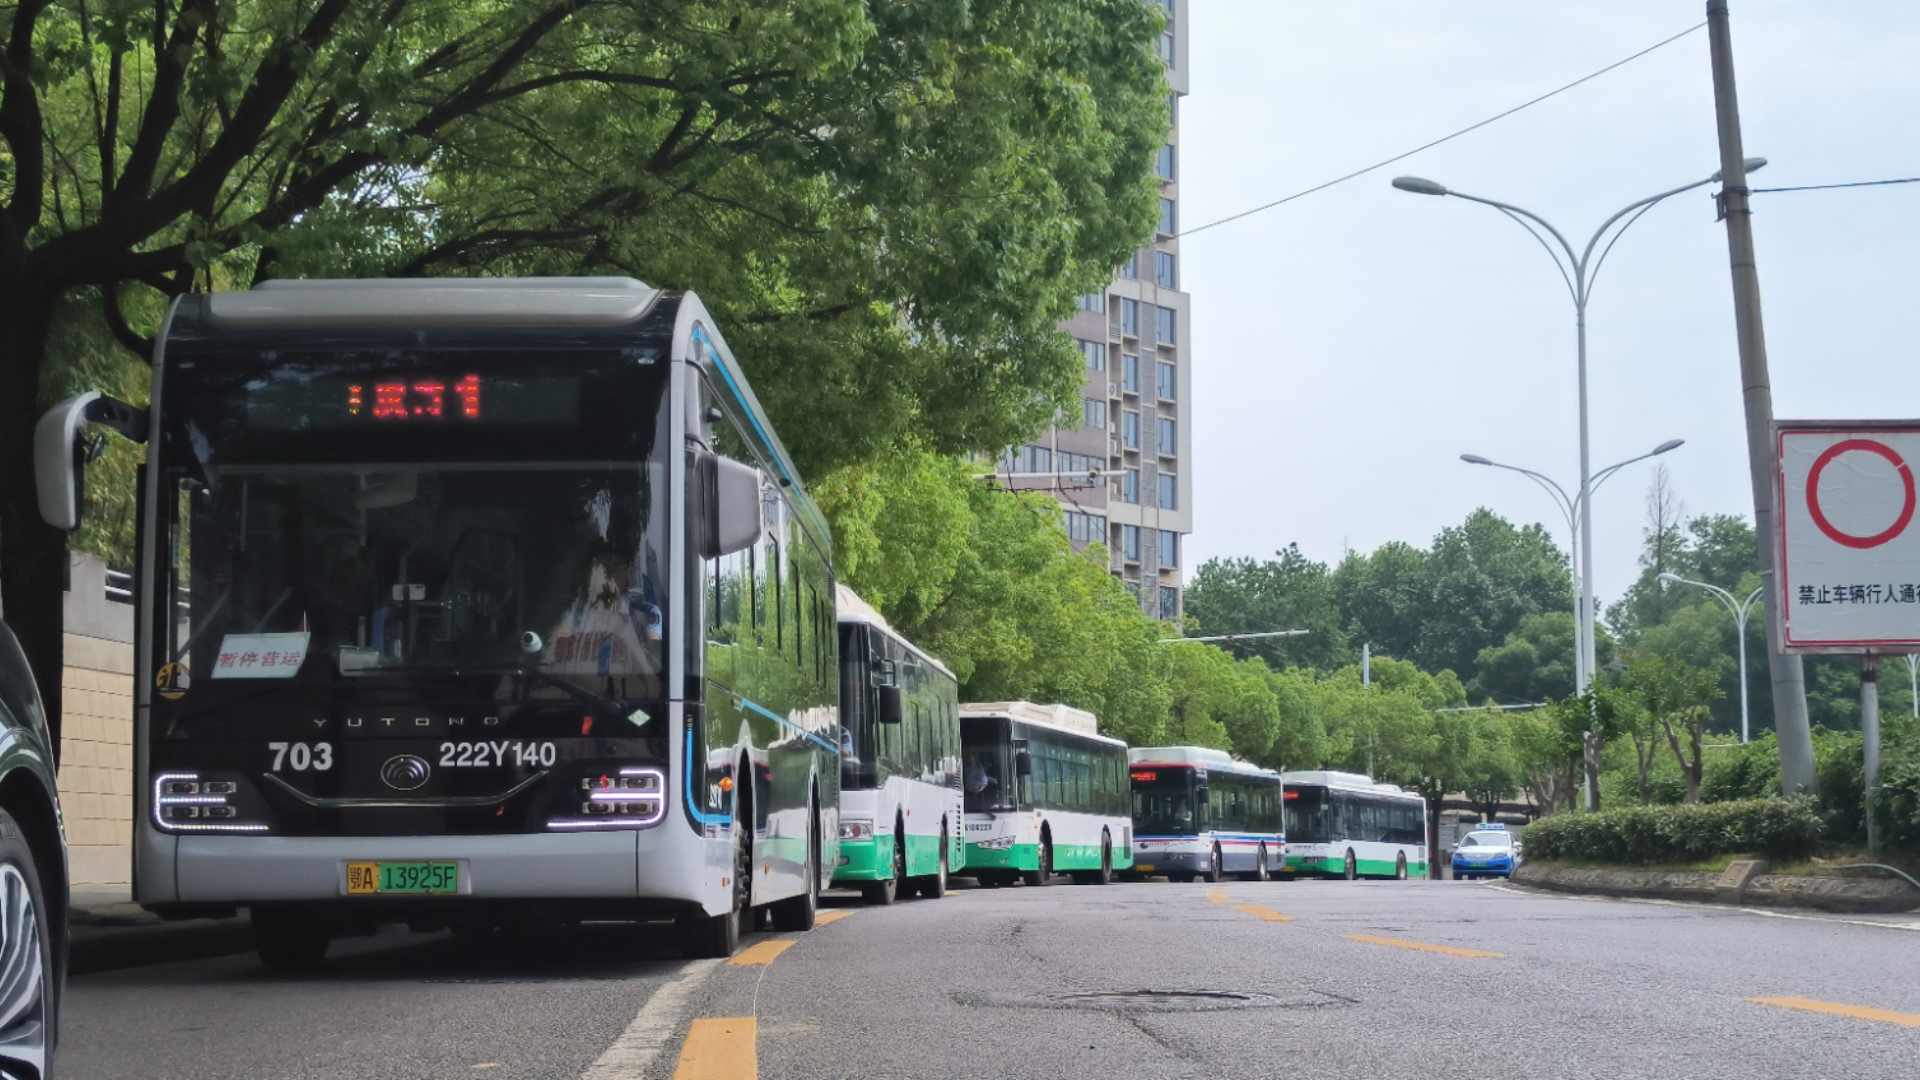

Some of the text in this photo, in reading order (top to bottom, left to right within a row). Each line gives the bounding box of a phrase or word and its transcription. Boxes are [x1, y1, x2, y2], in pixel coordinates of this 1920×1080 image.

[219, 651, 301, 668] 暂停营运
[312, 716, 500, 728] YUTONG
[268, 742, 333, 771] 703
[439, 741, 556, 767] 222Y140
[385, 865, 456, 890] 13925F
